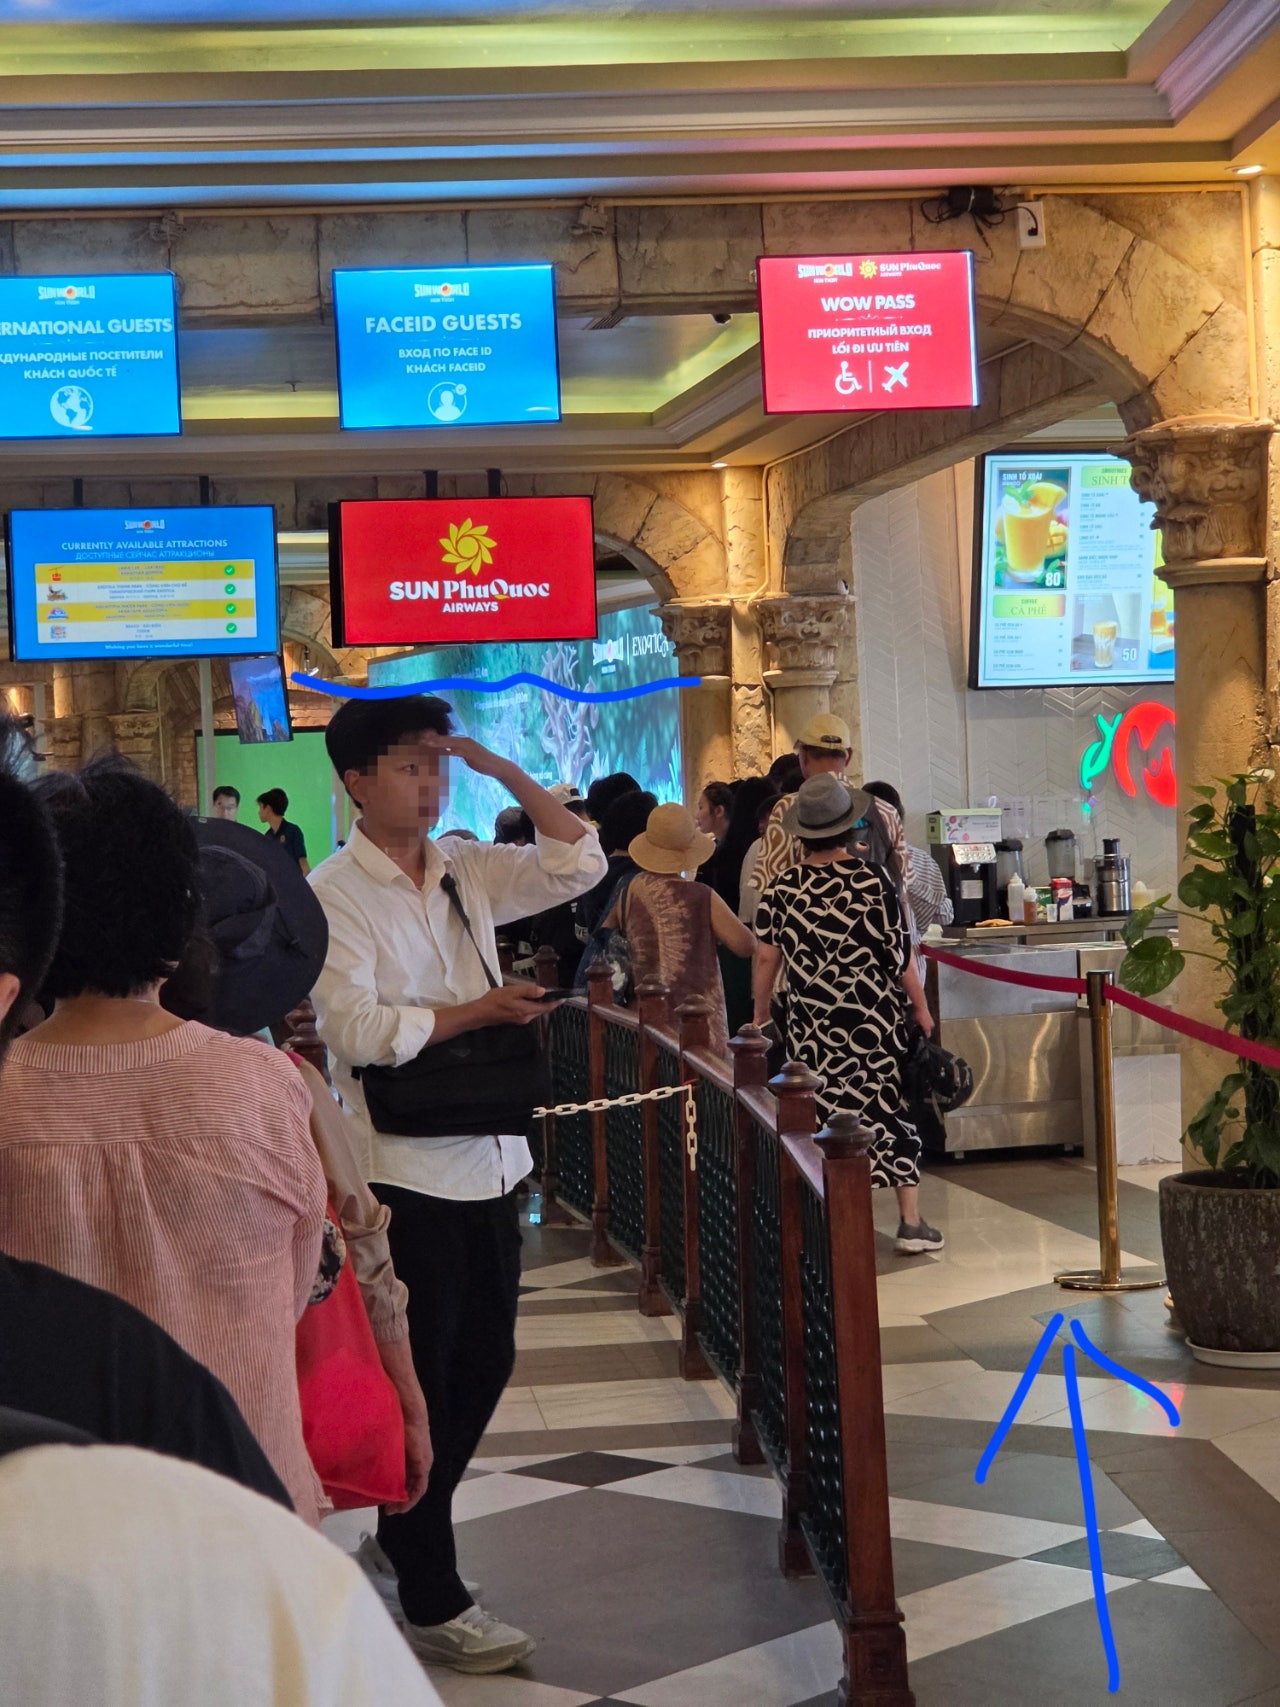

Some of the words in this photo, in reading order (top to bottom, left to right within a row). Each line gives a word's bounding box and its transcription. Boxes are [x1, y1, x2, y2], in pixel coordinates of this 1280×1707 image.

[879, 263, 899, 272] SUN
[821, 296, 872, 312] WOW
[875, 294, 915, 310] PASS
[0, 320, 104, 336] RNATIONAL
[108, 318, 173, 333] GUESTS
[365, 316, 437, 333] FACEID
[442, 313, 522, 331] GUESTS
[808, 324, 898, 338] ПРИОРИТЕТНЫЙ
[900, 325, 932, 336] ВХОД
[885, 340, 909, 352] TIÊN
[90, 350, 163, 361] ПОСЕТИТЕЛИ
[398, 348, 431, 359] ВХОД
[433, 347, 451, 357] ПО
[453, 347, 479, 357] FACE
[481, 346, 492, 356] ID
[24, 367, 65, 379] KHÁCH
[406, 362, 446, 374] KHÁCH
[449, 362, 486, 372] FACEID
[1091, 476, 1118, 486] SINH
[1121, 476, 1128, 486] T
[61, 541, 114, 550] CURRENTLY
[116, 540, 164, 549] AVAILABLE
[166, 539, 228, 548] ATTRACTIONS
[1044, 572, 1061, 587] 80
[389, 580, 440, 601] SUN
[443, 579, 550, 601] PhuQuoc
[442, 601, 499, 613] AIRWAYS
[1122, 648, 1137, 661] 50
